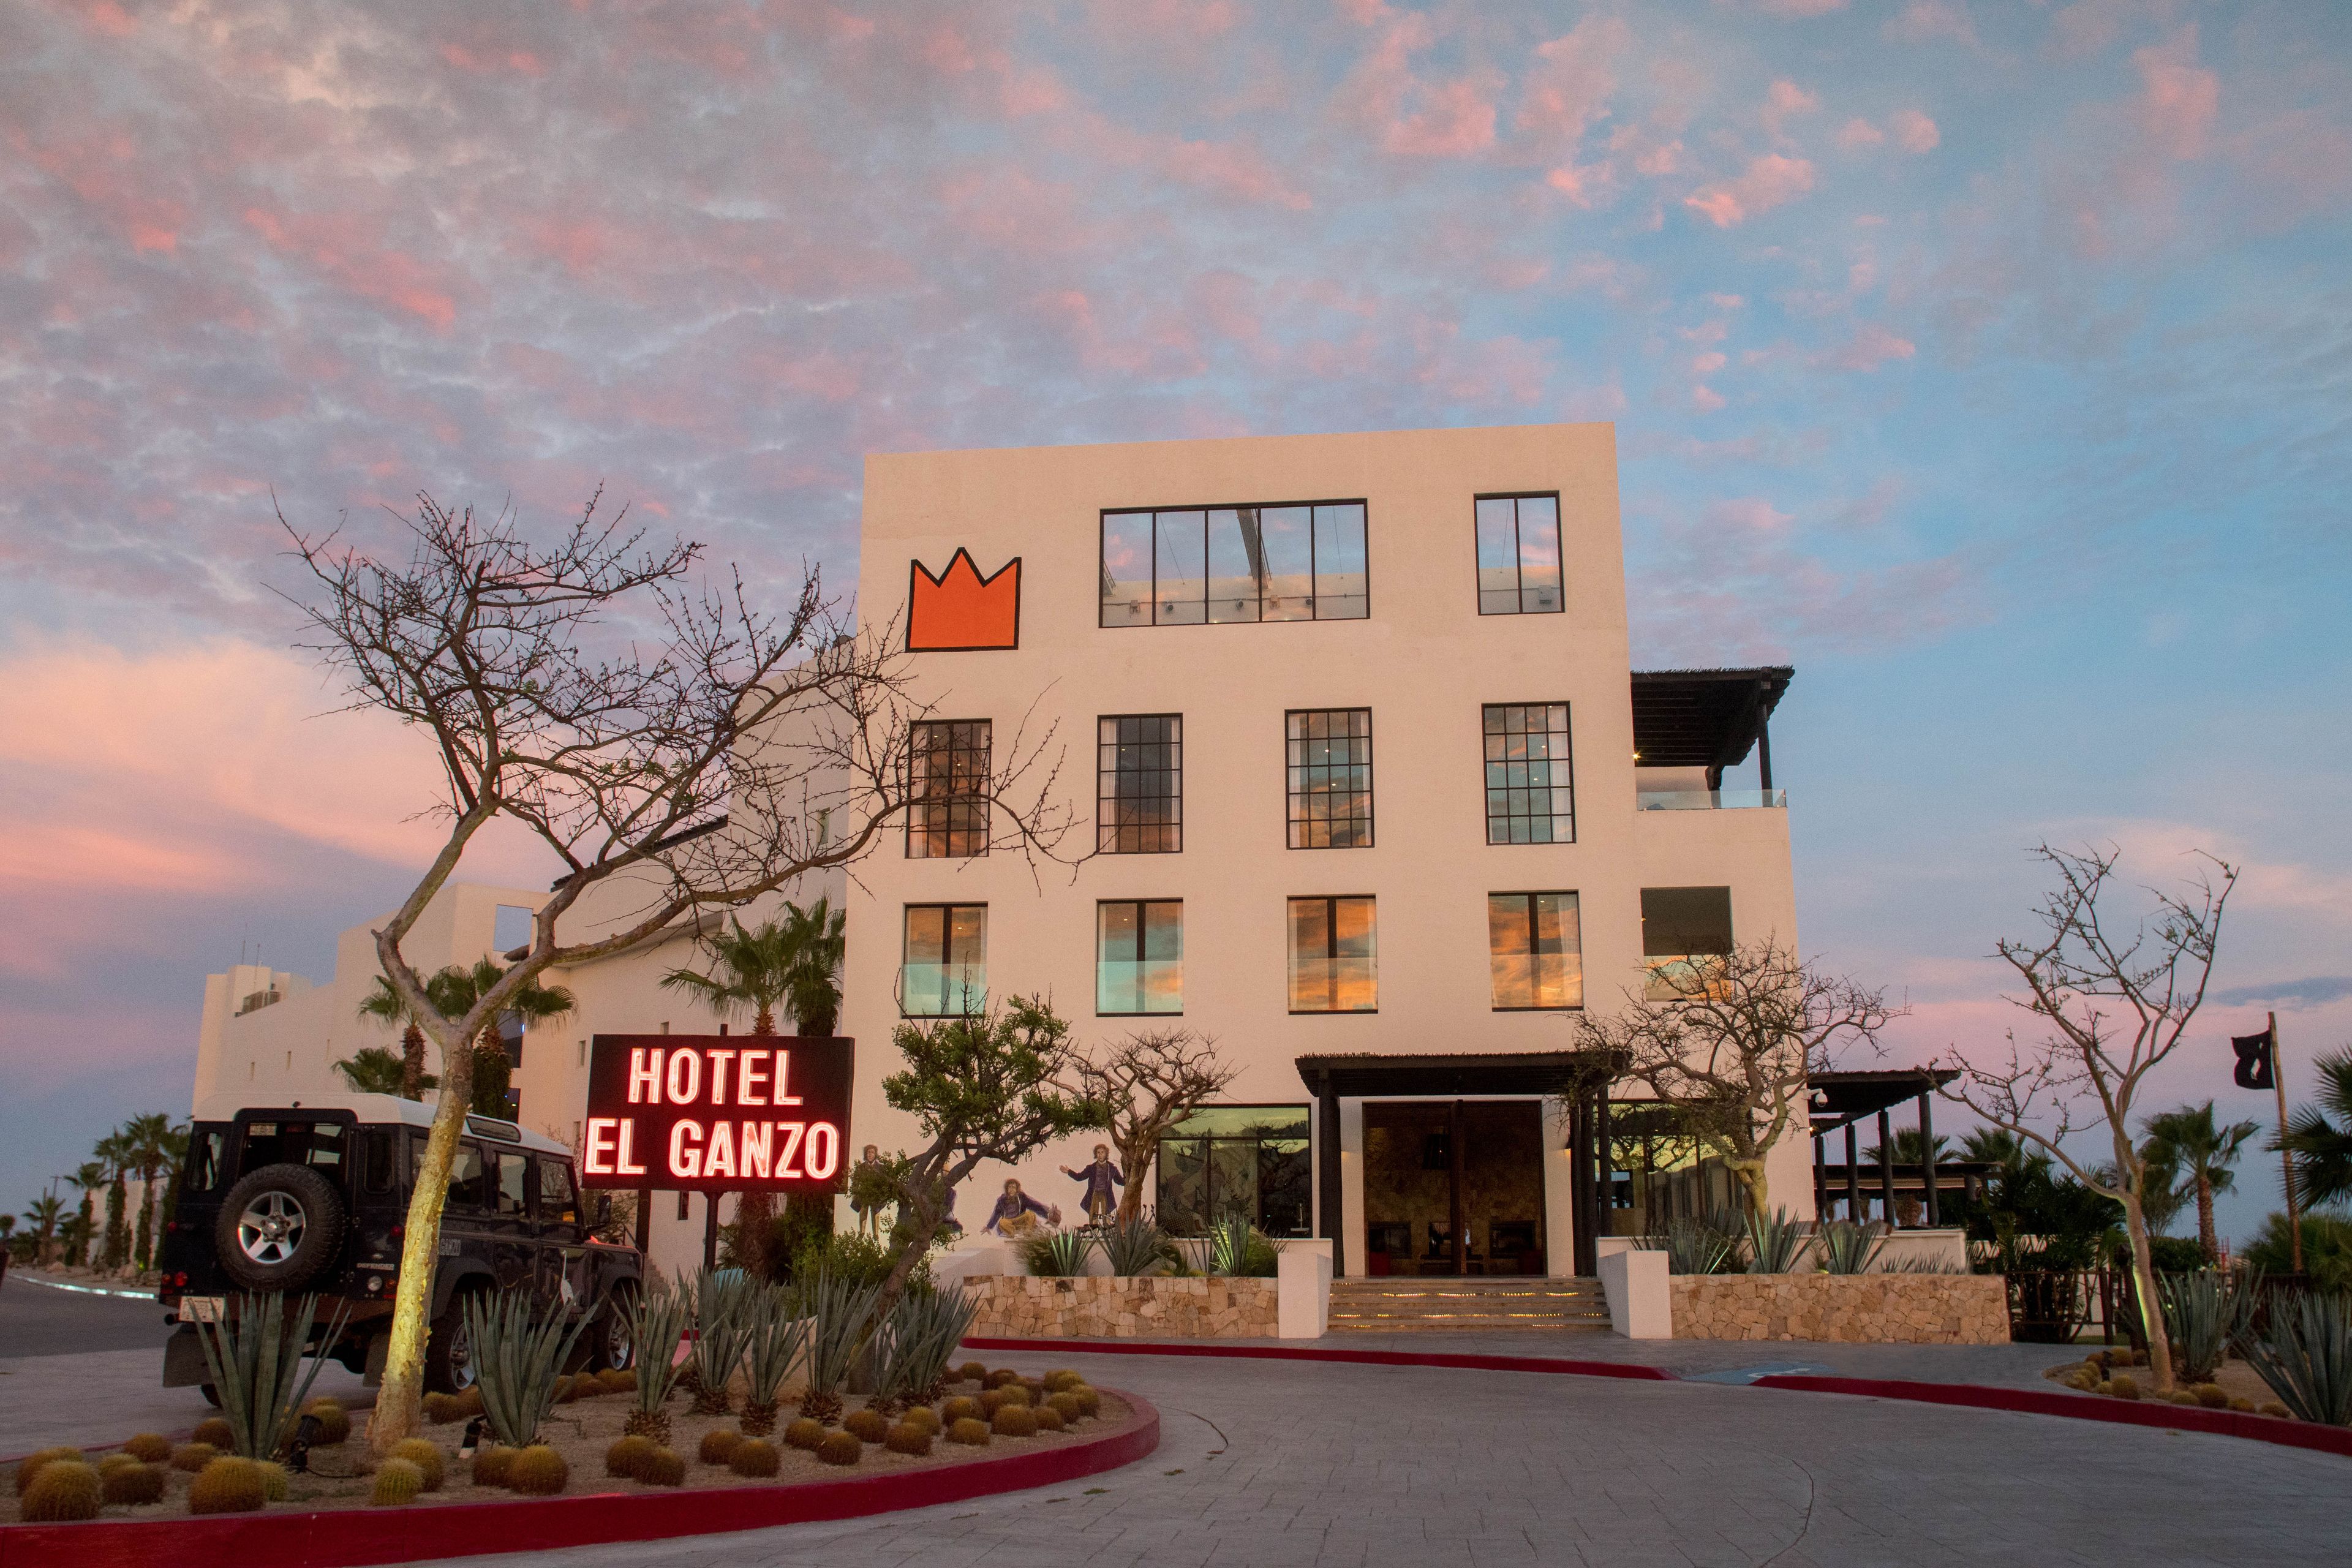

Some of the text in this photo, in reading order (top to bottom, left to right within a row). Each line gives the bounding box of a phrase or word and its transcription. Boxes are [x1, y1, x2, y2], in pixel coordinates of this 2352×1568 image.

[627, 1047, 804, 1106] HOTEL
[584, 1118, 840, 1179] EL GANZO
